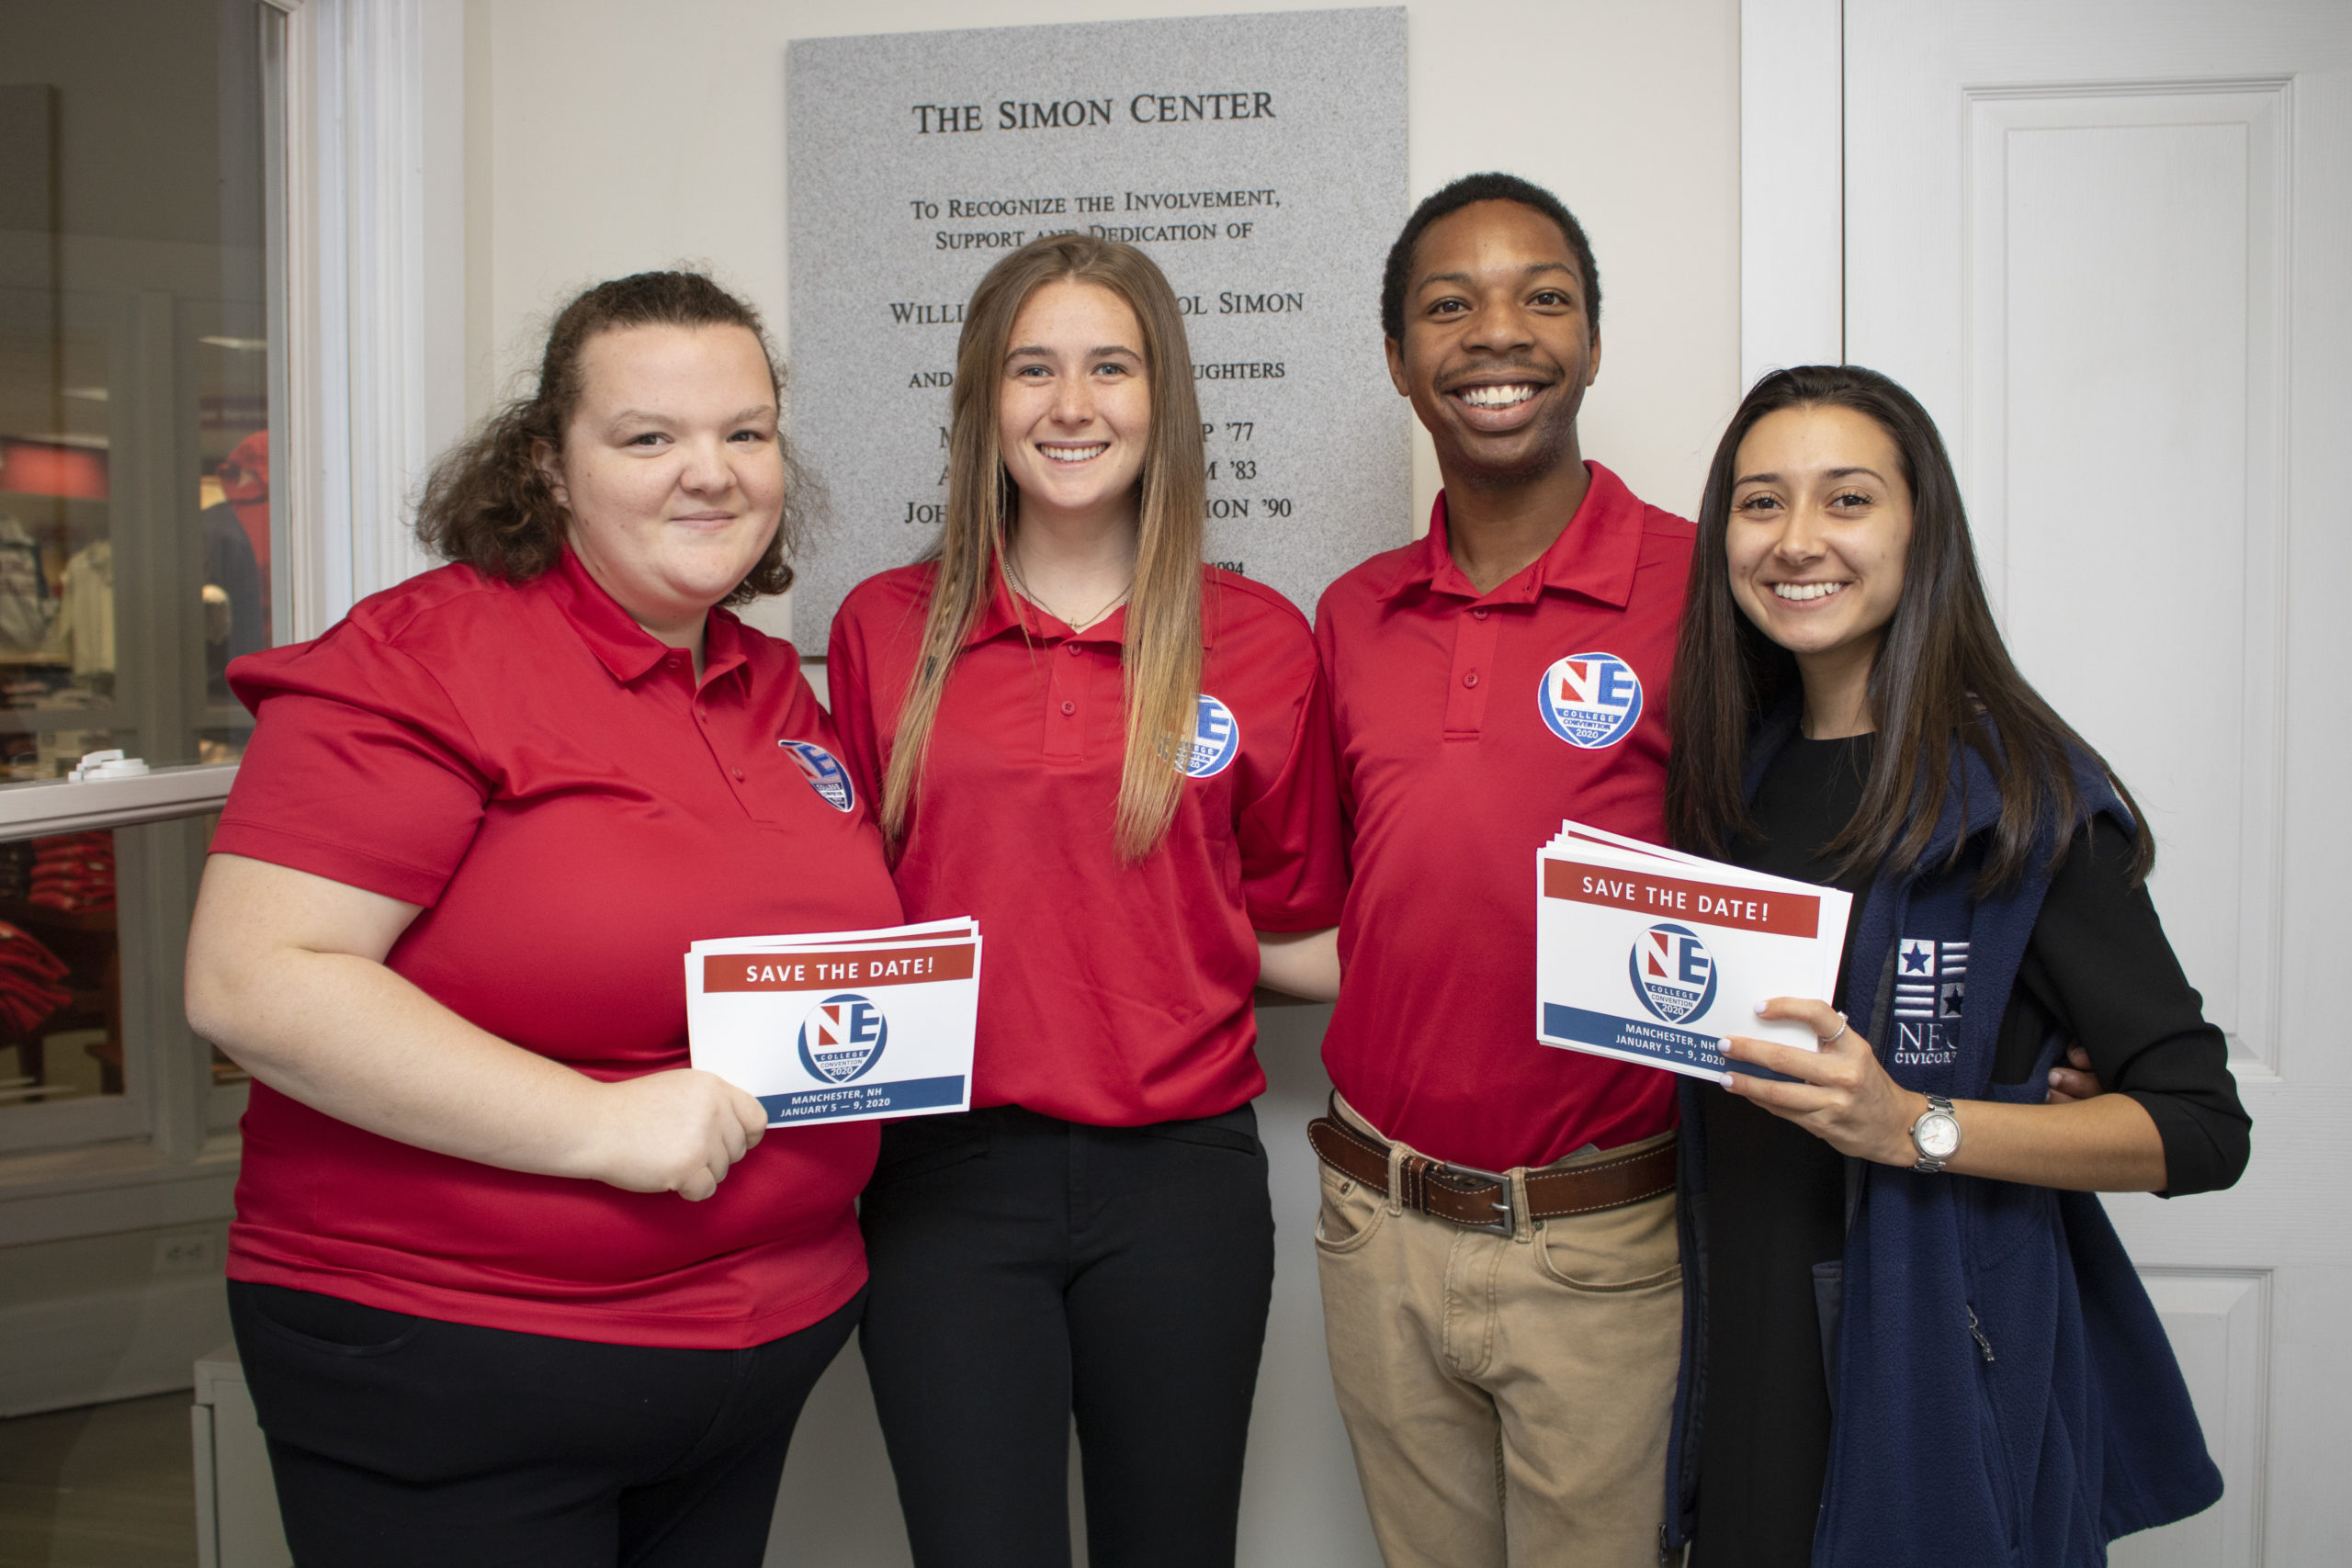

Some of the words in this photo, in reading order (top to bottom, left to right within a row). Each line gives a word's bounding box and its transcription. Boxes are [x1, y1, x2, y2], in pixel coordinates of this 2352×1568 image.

[912, 104, 982, 133] THE
[999, 98, 1113, 130] SIMON
[1130, 92, 1276, 123] CENTER
[910, 200, 939, 220] TO
[947, 197, 1066, 218] RECOGNIZE
[1075, 196, 1114, 212] THE
[1124, 189, 1281, 211] INVOLVEMENT,
[935, 231, 1024, 250] SUPPORT
[1227, 222, 1253, 239] OF
[888, 301, 964, 324] WILLI
[1218, 291, 1305, 314] SIMON
[907, 371, 954, 389] AND
[1191, 362, 1285, 381] UGHTERS
[1553, 660, 1634, 707] NE
[1563, 709, 1614, 723] COLLEGE
[1563, 718, 1611, 730] CONVENTION
[1576, 729, 1599, 739] 2020
[1582, 876, 1635, 901] SAVE
[1645, 886, 1687, 909] THE
[1699, 895, 1769, 922] DATE!
[746, 964, 805, 983] SAVE
[816, 961, 859, 980] THE
[870, 956, 933, 977] DATE!
[1640, 931, 1709, 985] NE
[1651, 985, 1694, 1000] COLLEGE
[1651, 994, 1693, 1008] CONVENTION
[812, 1002, 880, 1044] NE
[1662, 1004, 1684, 1015] 2020
[1616, 1034, 1662, 1052] JANUARY
[1665, 1045, 1671, 1055] 5
[1688, 1050, 1697, 1061] 9,
[1701, 1053, 1725, 1066] 2020
[1625, 1023, 1697, 1048] MANCHESTER,
[1701, 1040, 1716, 1052] NH
[820, 1051, 864, 1061] COLLEGE
[820, 1059, 863, 1068] CONVENTION
[831, 1066, 853, 1076] 2020
[780, 1104, 828, 1118] JANUARY
[854, 1101, 863, 1111] 9,
[866, 1098, 890, 1108] 2020
[792, 1090, 864, 1105] MANCHESTER,
[866, 1088, 882, 1097] NH
